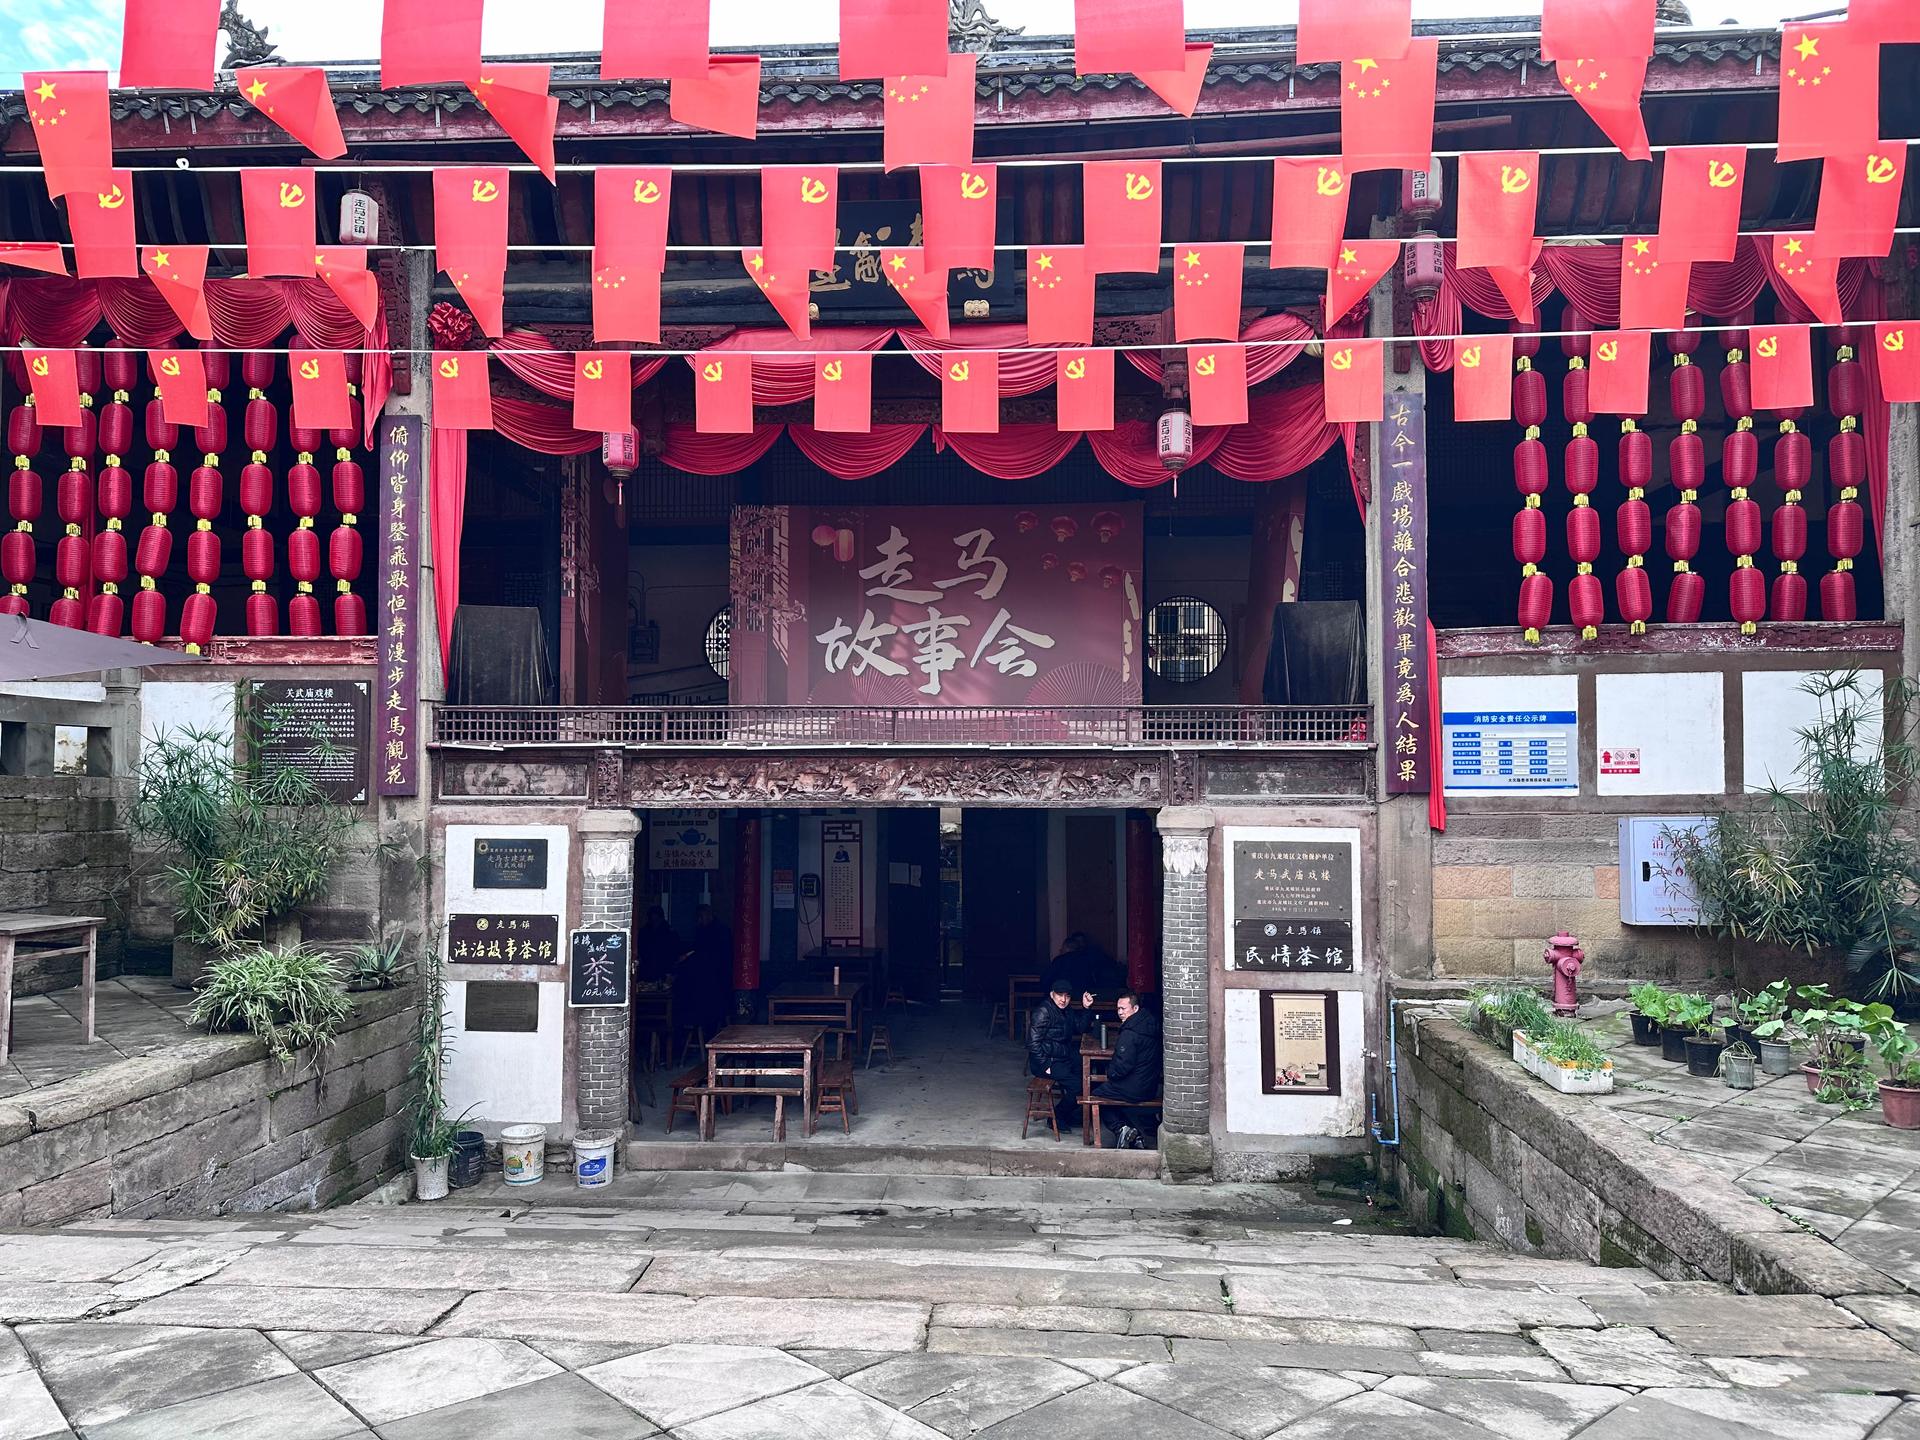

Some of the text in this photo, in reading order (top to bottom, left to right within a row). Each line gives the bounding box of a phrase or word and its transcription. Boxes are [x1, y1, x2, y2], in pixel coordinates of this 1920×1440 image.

[1413, 170, 1426, 199] 马古镇
[354, 199, 366, 234] 走马古镇
[623, 433, 633, 460] 马古镇
[1161, 418, 1170, 452] 走马古镇
[859, 525, 1009, 605] 走马
[815, 606, 1056, 696] 故事会
[1473, 714, 1548, 723] 消防安全责任公示牌
[1251, 852, 1334, 861] 重庆市九龙坡区文物保护单位
[1254, 868, 1331, 881] 走马武庙戏楼
[454, 937, 552, 962] 法治故事茶馆
[1246, 944, 1343, 967] 民情茶馆
[583, 953, 615, 986] 茶
